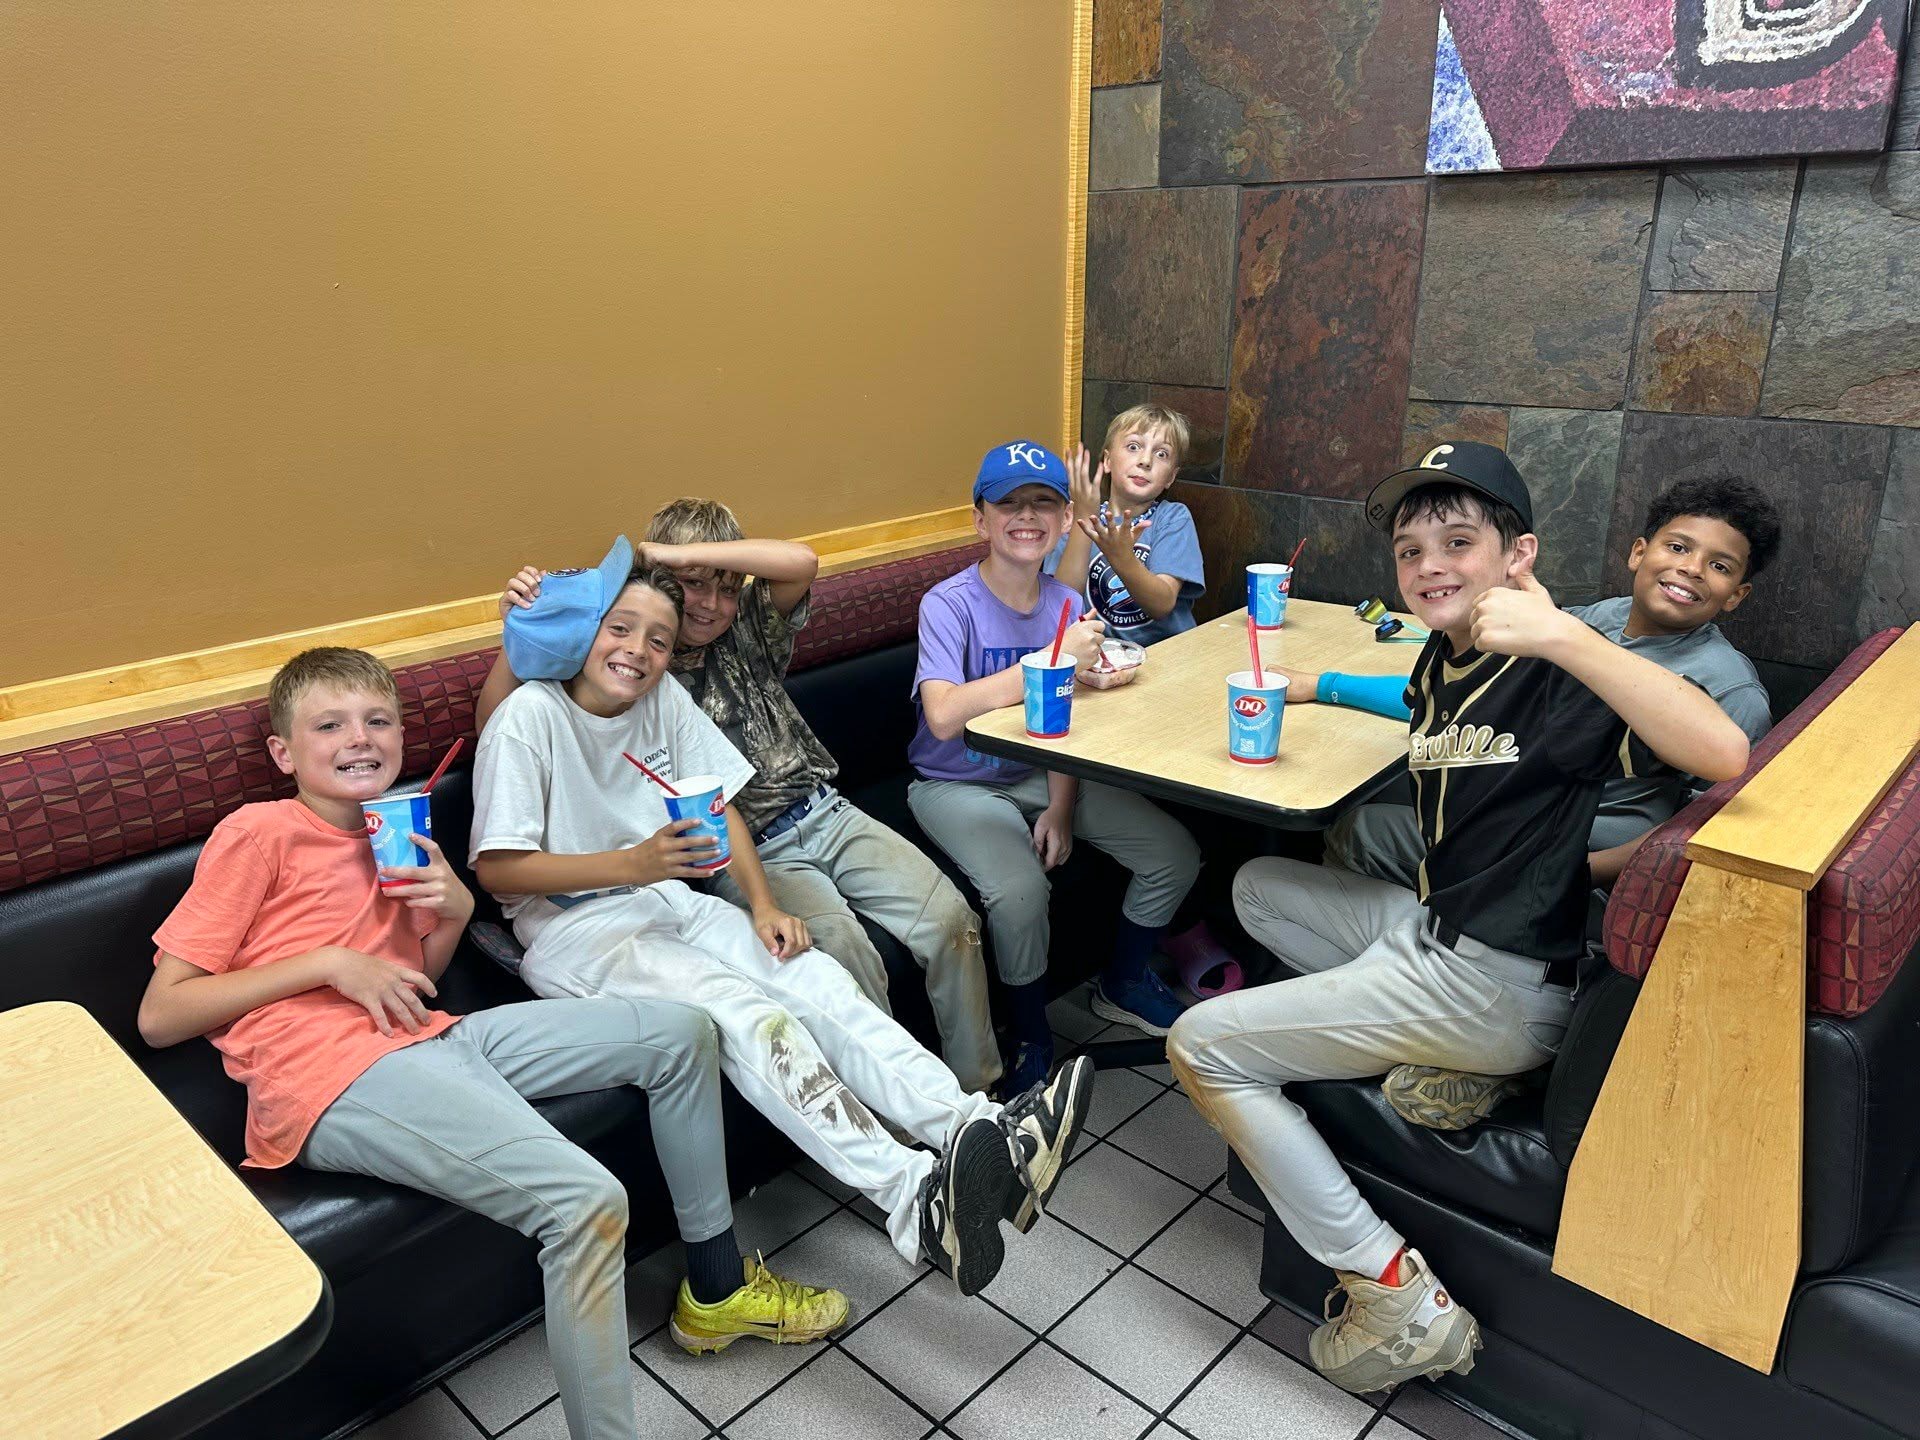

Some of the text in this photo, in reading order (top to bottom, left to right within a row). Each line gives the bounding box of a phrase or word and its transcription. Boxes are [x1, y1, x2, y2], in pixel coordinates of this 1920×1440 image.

[1005, 443, 1046, 470] KC
[1419, 444, 1455, 469] C
[1091, 560, 1107, 580] 931
[1239, 699, 1262, 714] DQ
